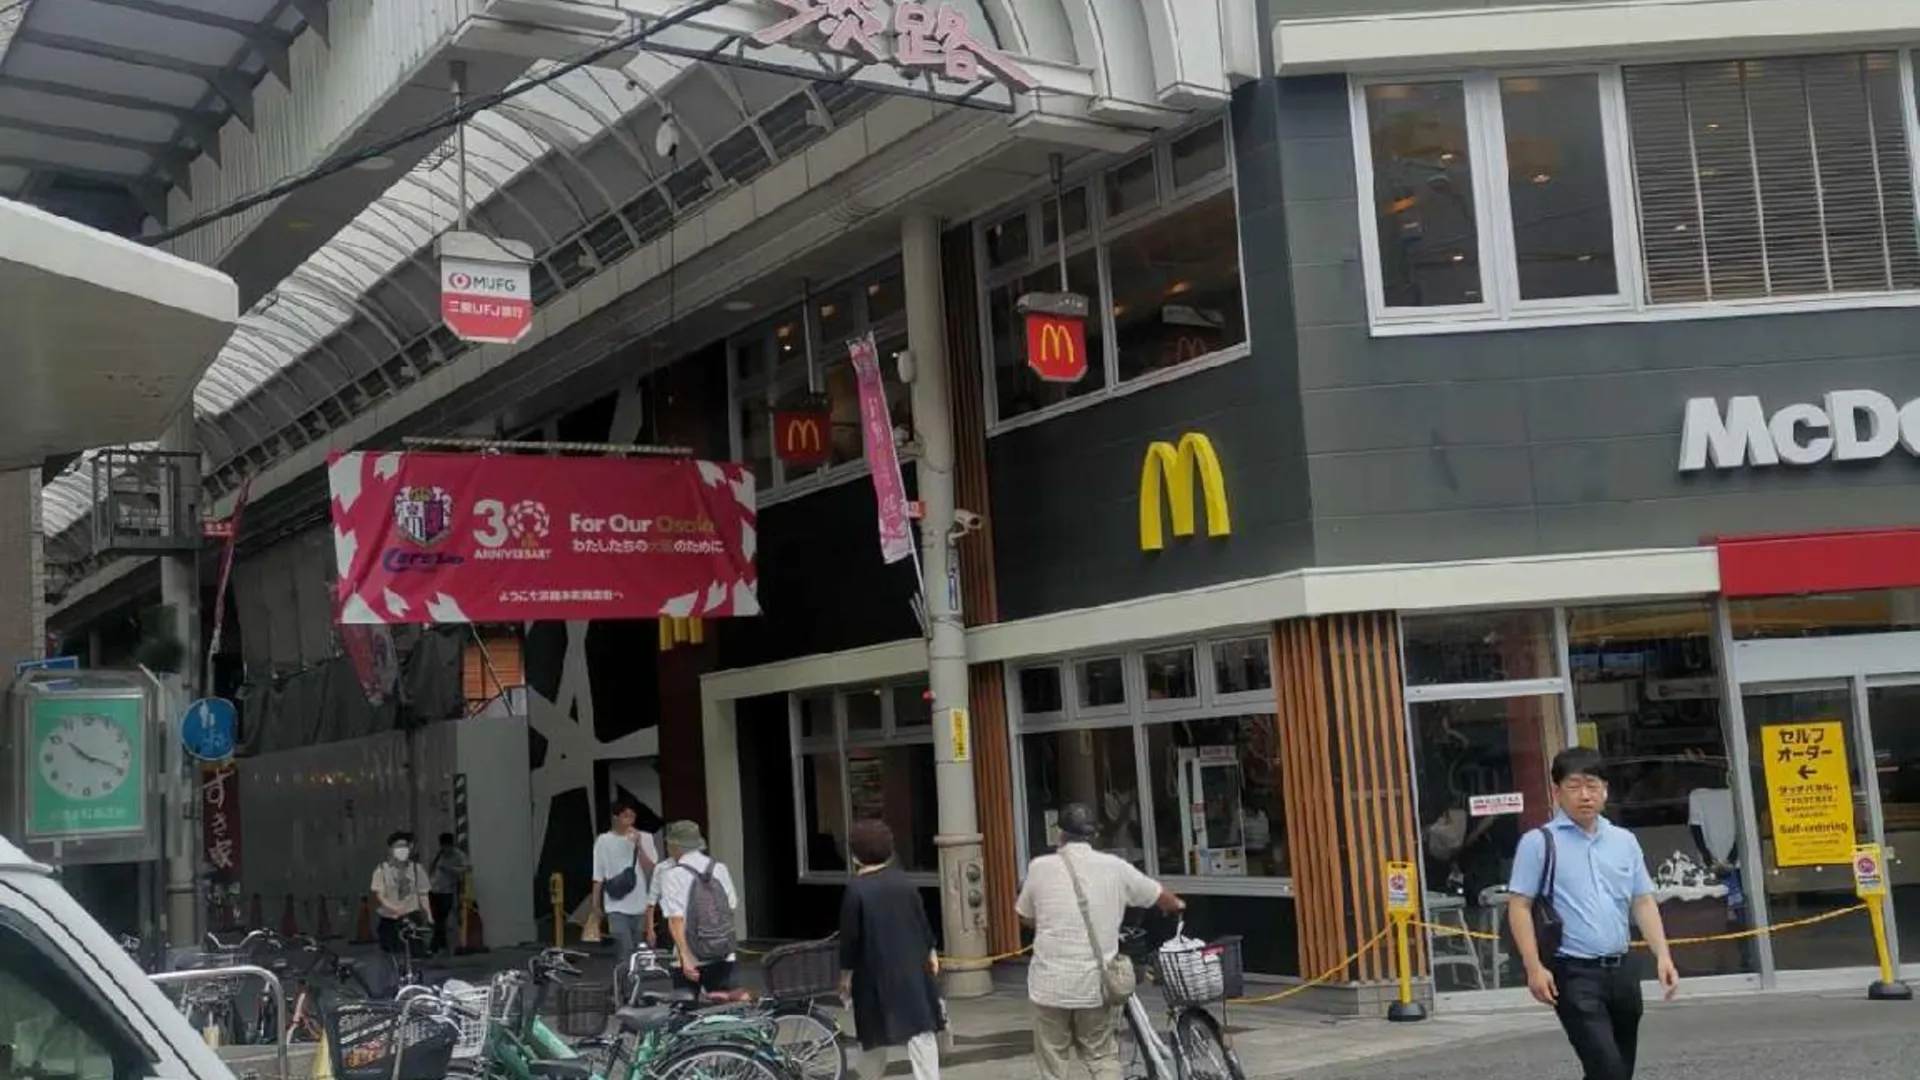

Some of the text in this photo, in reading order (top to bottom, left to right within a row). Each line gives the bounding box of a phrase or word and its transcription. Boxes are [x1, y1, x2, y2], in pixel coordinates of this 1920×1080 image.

[473, 276, 516, 292] MUFG
[447, 300, 524, 320] 三UFJ行
[570, 513, 605, 532] For
[609, 514, 652, 532] Our
[1779, 728, 1825, 744] セルフ
[1778, 746, 1833, 762] オーダー
[203, 769, 237, 868] すき家
